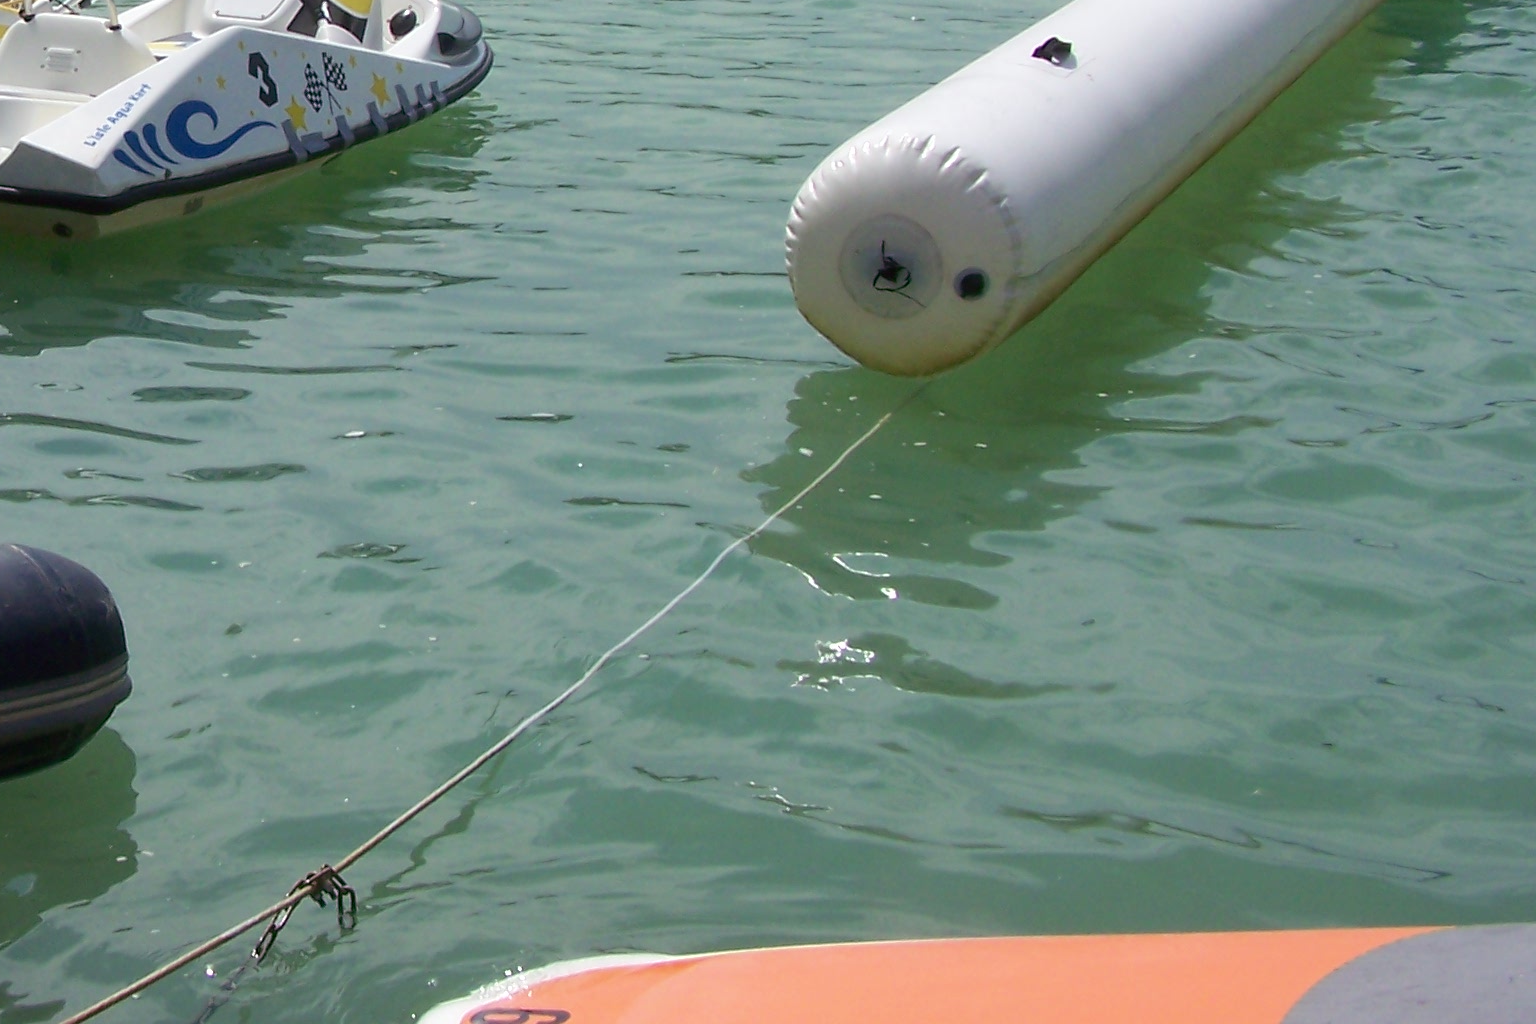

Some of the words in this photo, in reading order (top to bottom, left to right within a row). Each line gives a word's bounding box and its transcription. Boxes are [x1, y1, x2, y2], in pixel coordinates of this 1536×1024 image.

[106, 102, 134, 125] Aqua
[128, 83, 152, 102] Kart
[248, 51, 279, 108] 3
